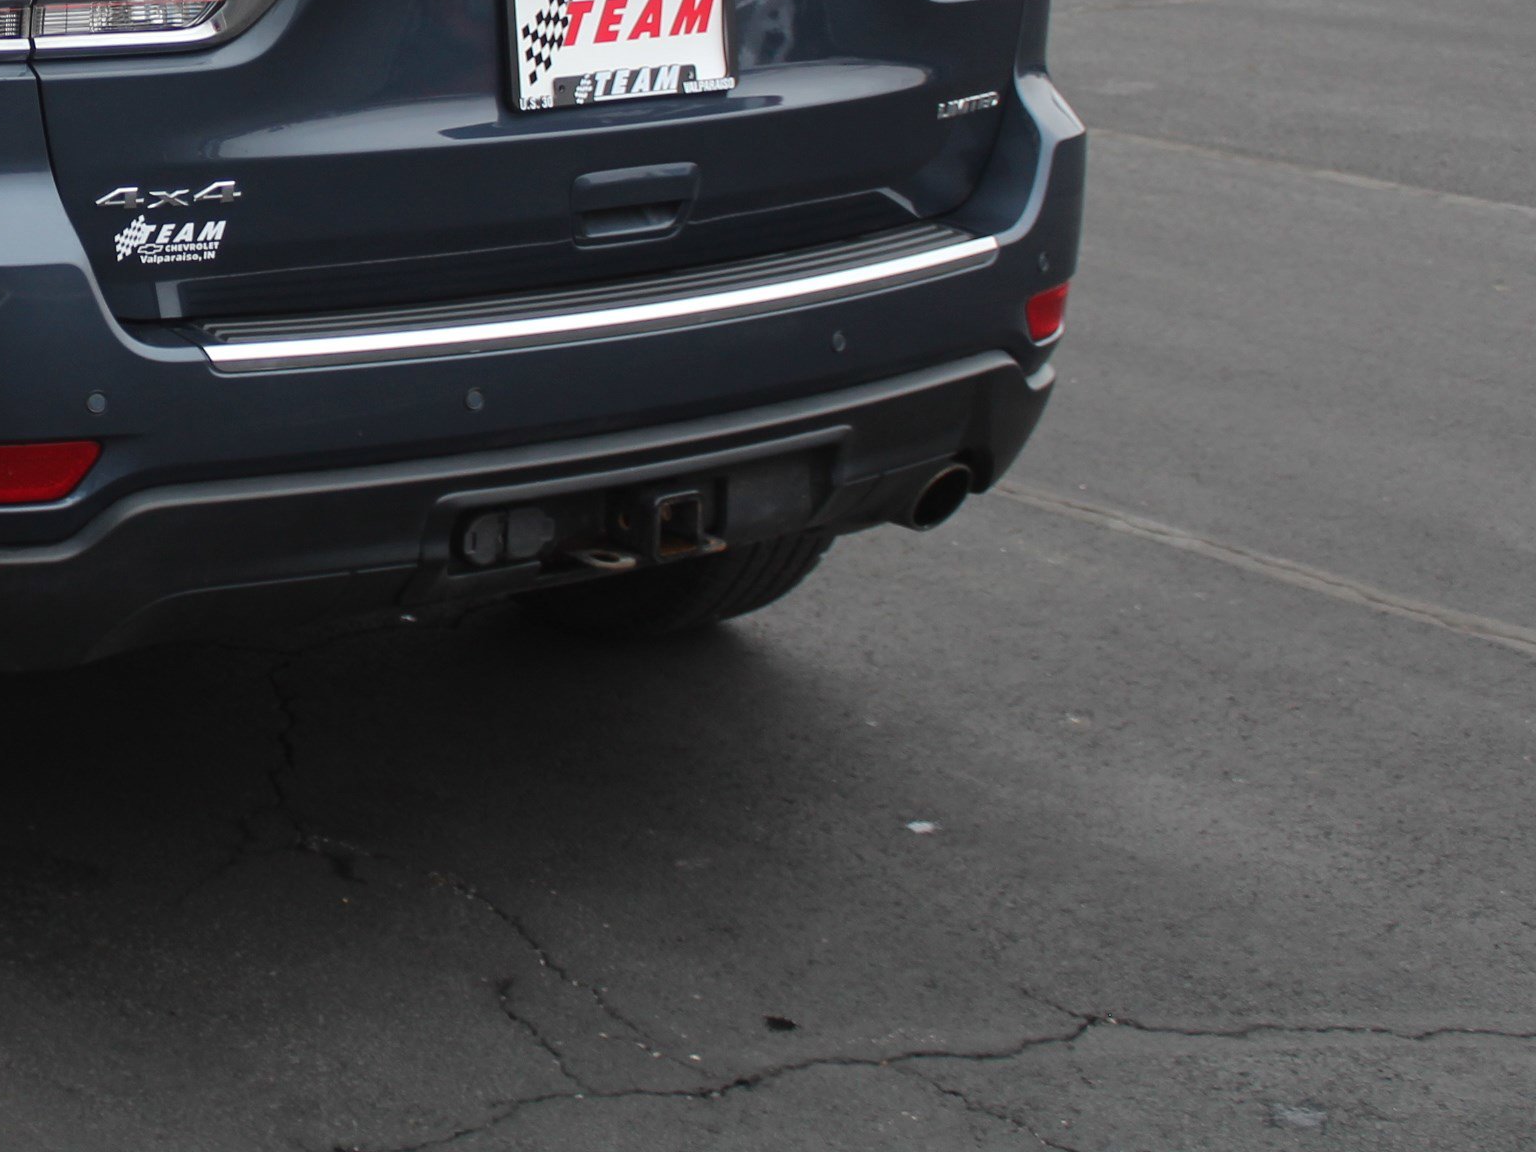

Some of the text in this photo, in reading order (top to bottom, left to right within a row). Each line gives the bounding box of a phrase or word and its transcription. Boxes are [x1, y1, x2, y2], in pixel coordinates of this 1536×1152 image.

[594, 64, 681, 98] TEAM
[138, 220, 227, 245] TEAM
[165, 241, 220, 253] CHEVROLET
[140, 250, 216, 264] Valparaiso, IN
